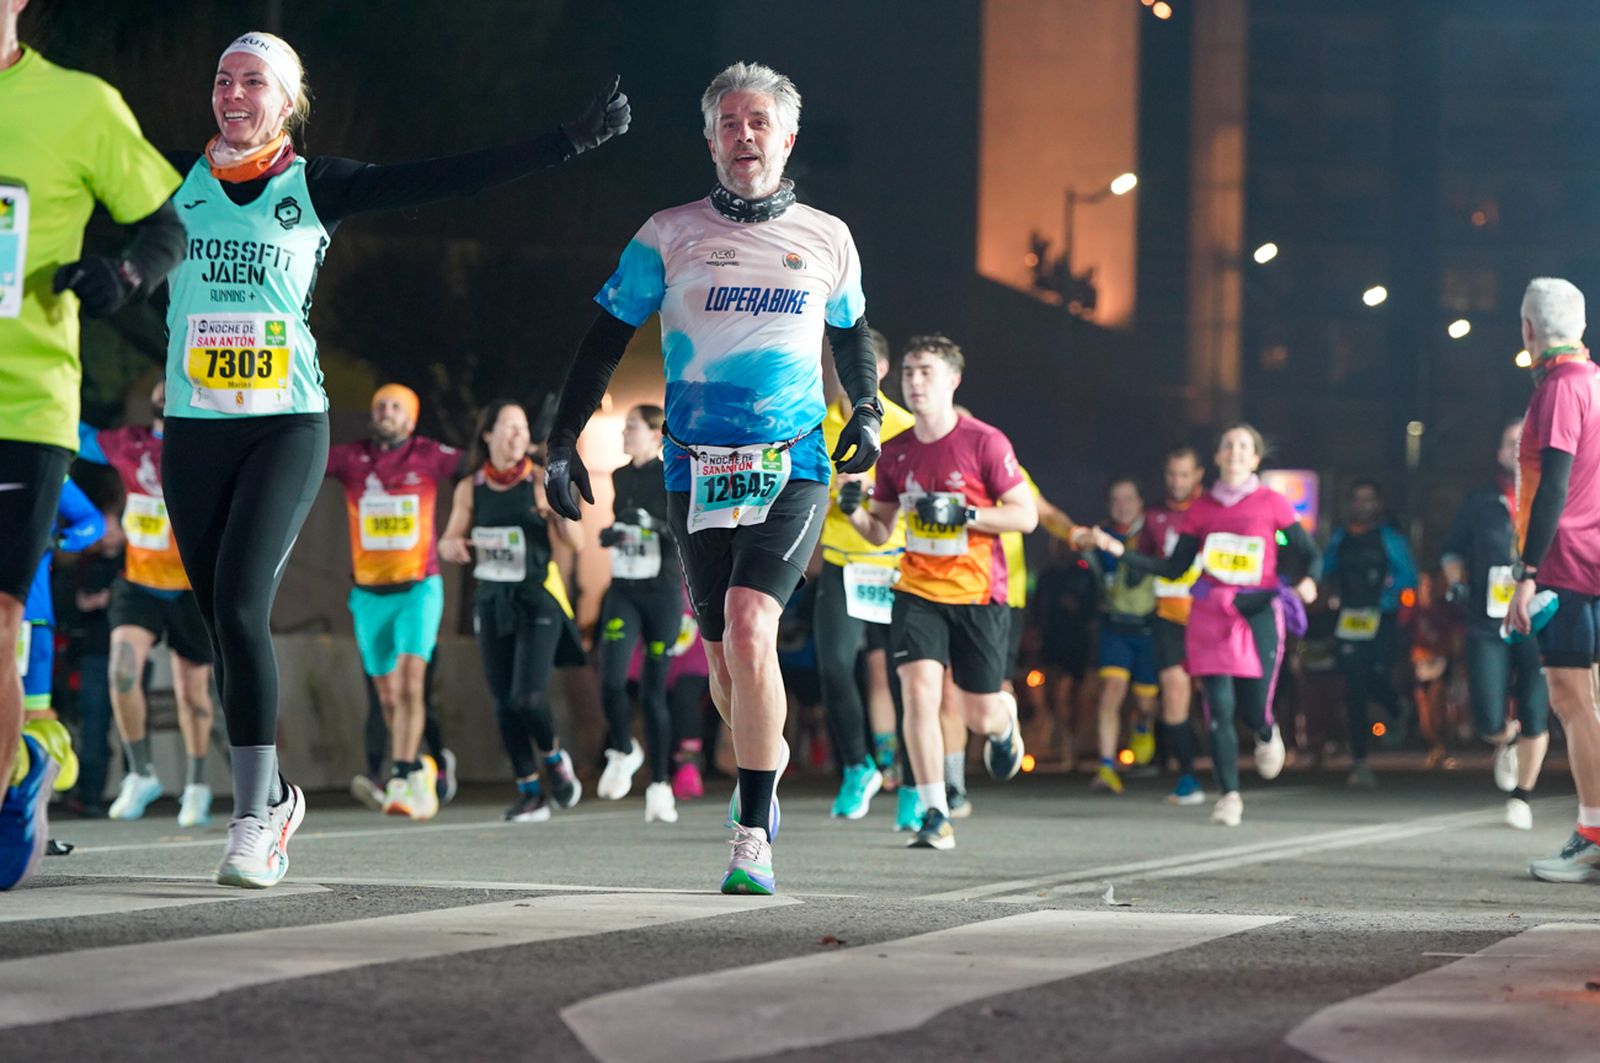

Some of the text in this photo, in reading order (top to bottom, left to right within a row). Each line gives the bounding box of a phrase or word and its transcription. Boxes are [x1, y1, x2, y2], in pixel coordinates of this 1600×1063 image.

[189, 238, 296, 272] ROSSFIT
[201, 261, 266, 286] JAEN
[210, 288, 246, 303] RUNNING
[704, 286, 810, 317] LOPERABIKE
[197, 336, 216, 347] SAN
[209, 324, 240, 334] NOCHE
[242, 324, 255, 334] DE
[205, 350, 273, 378] 7303
[703, 465, 720, 475] SAN
[704, 472, 777, 503] 12645
